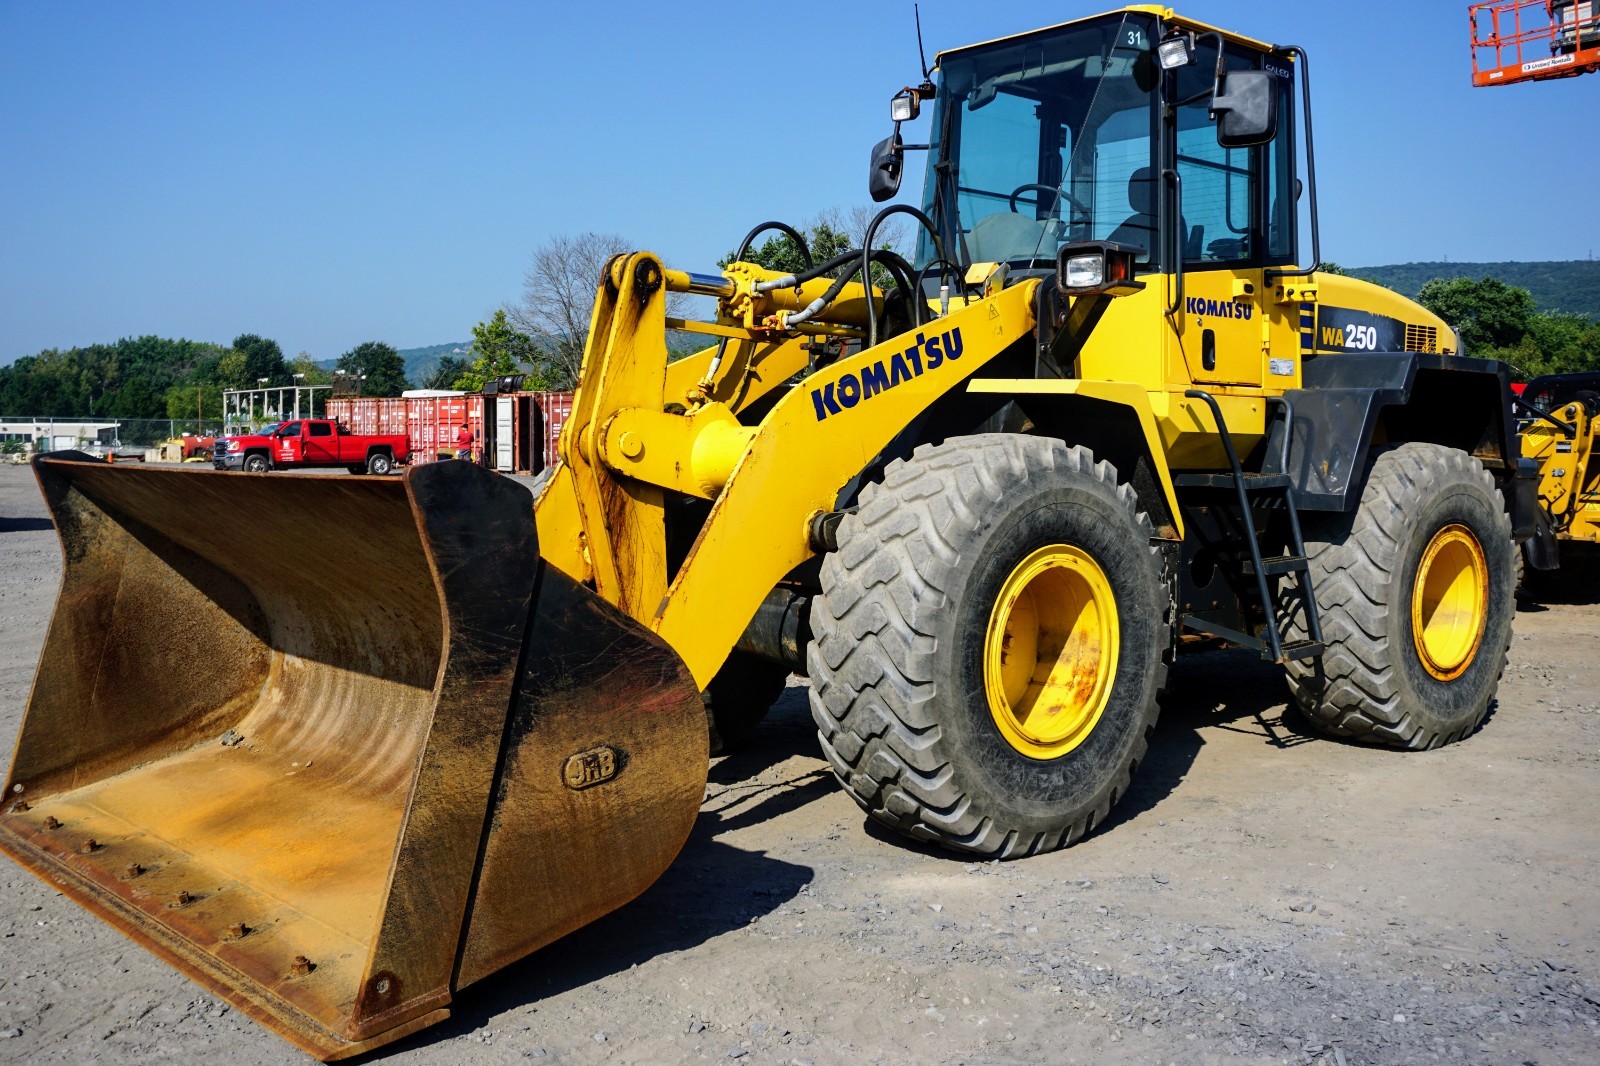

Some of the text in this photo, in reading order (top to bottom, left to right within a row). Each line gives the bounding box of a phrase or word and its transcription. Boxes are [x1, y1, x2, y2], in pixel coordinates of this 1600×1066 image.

[1127, 31, 1141, 45] 31
[1531, 54, 1572, 69] United Rentals
[1186, 297, 1252, 320] KOMATSU
[1322, 324, 1377, 350] WA 250
[811, 327, 964, 422] KOMATSU
